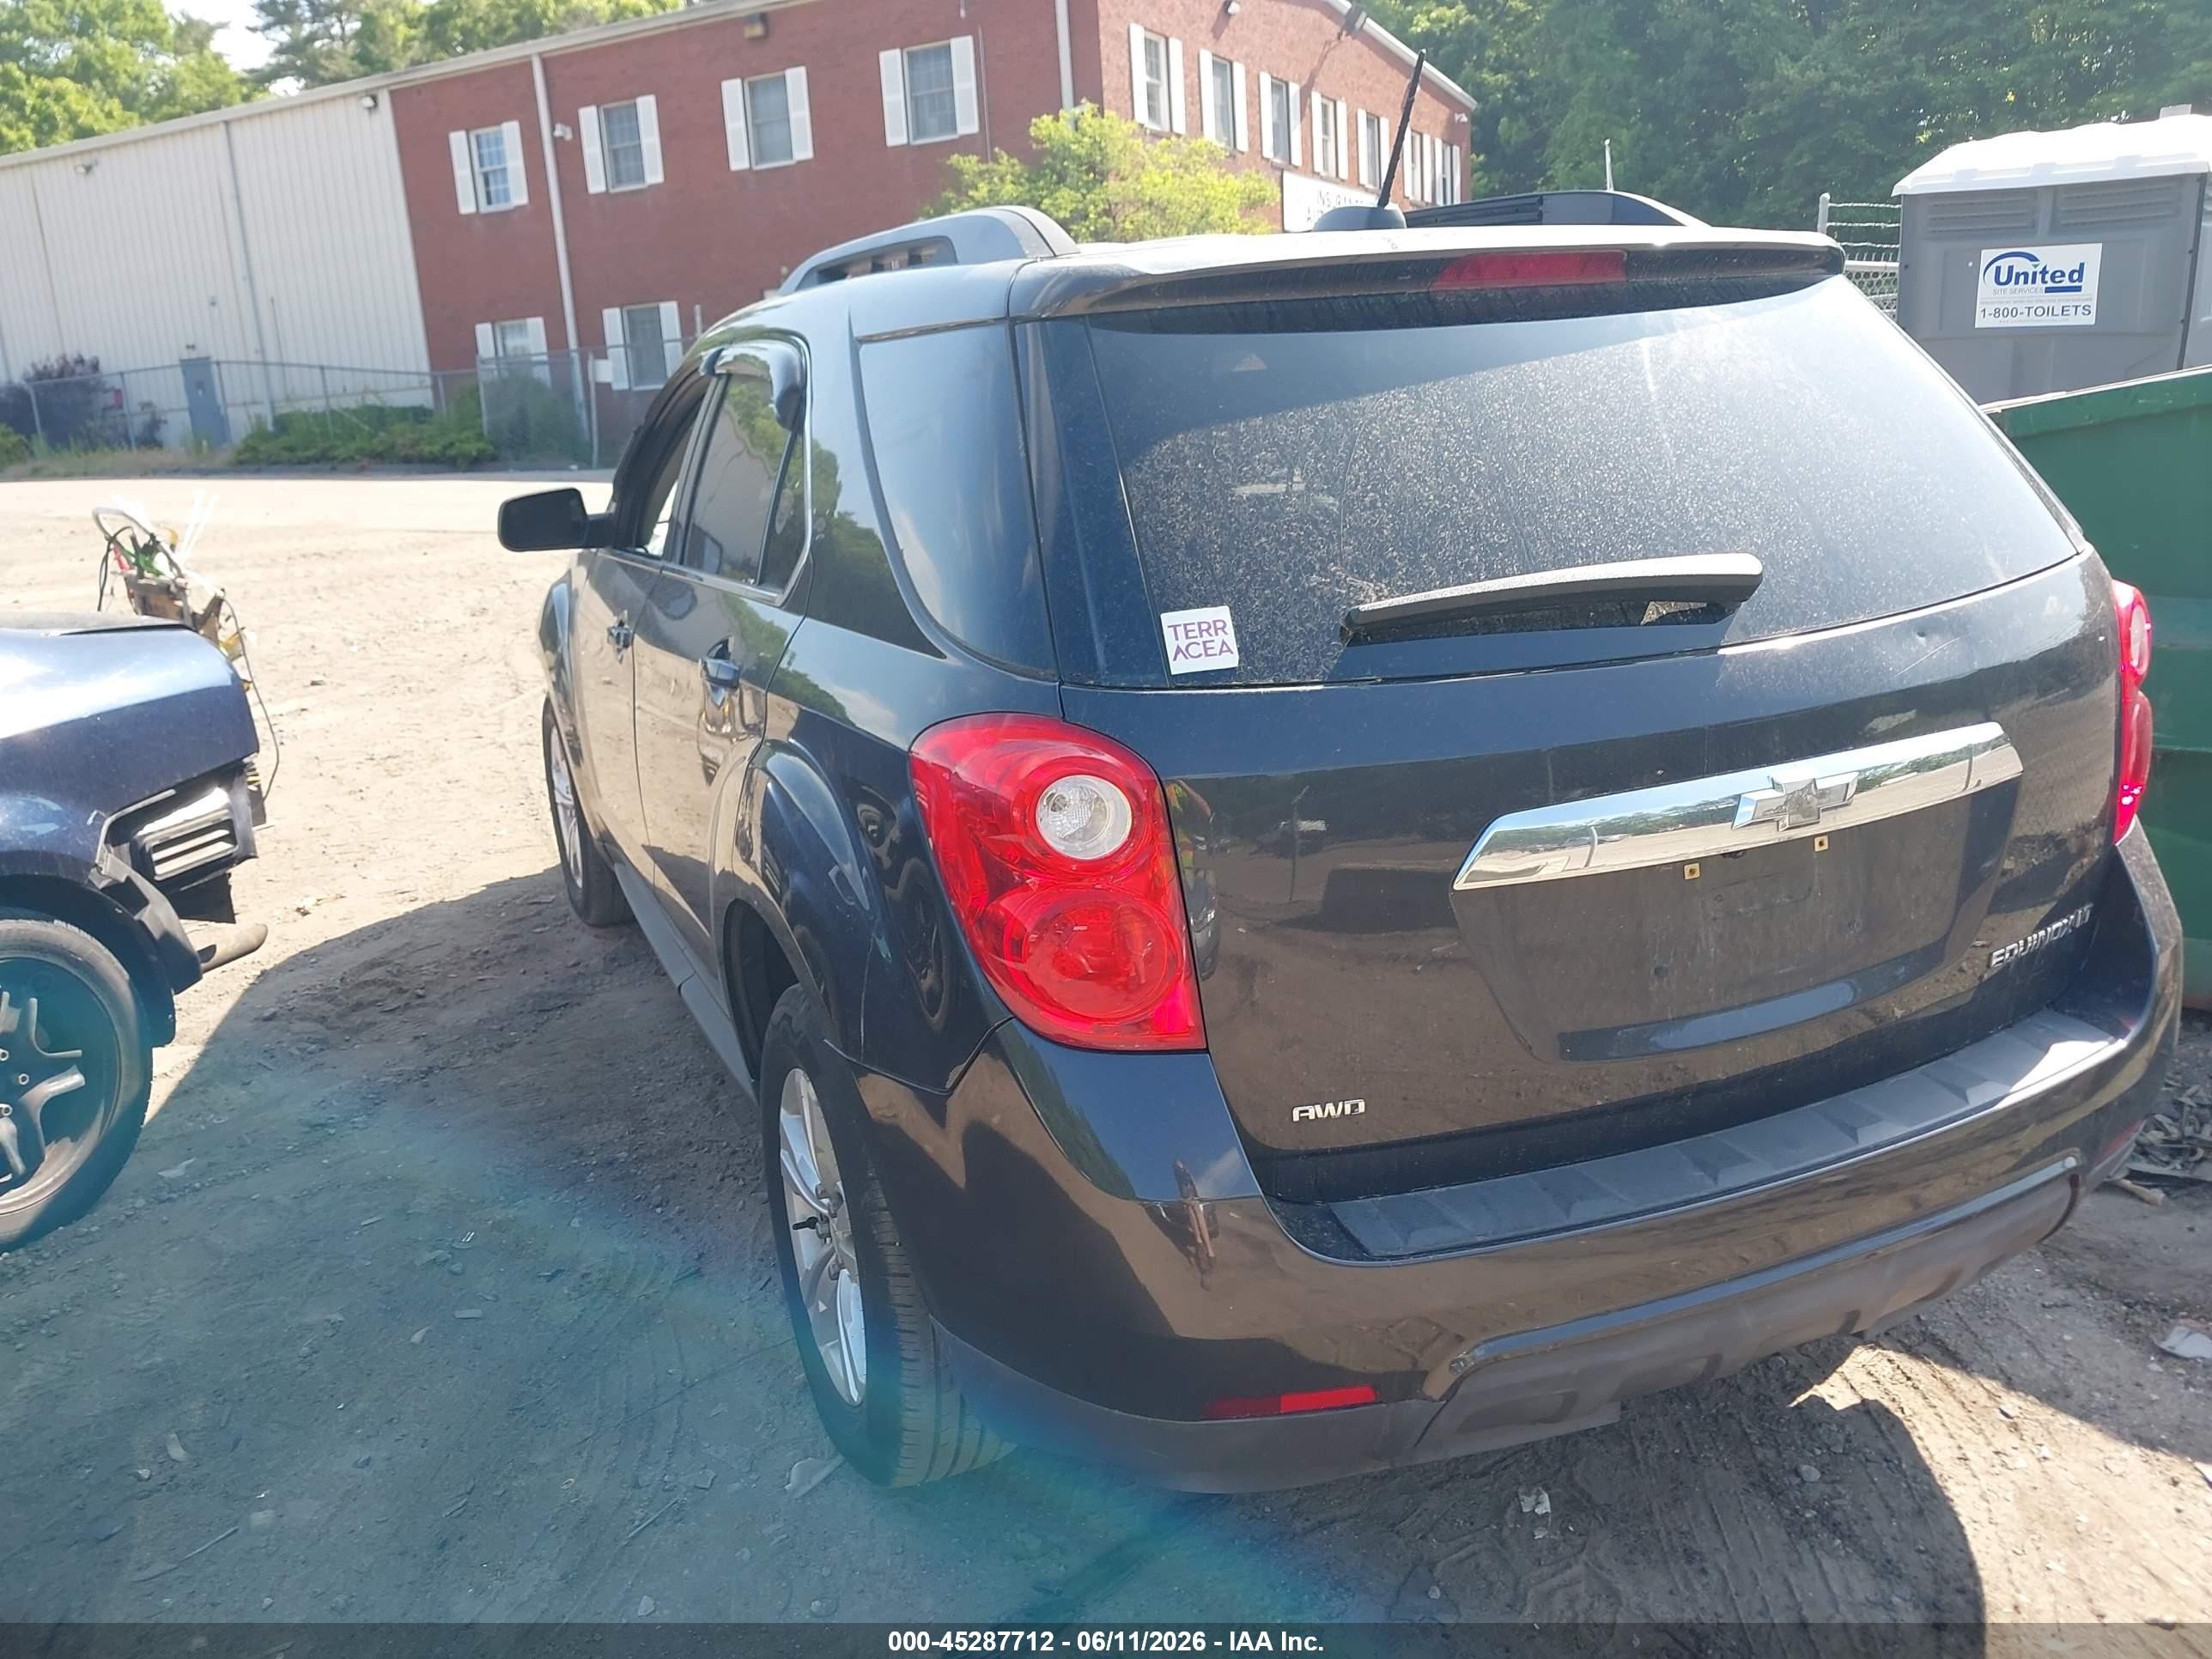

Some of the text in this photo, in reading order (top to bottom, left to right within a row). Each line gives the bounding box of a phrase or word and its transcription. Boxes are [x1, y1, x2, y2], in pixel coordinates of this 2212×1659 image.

[1994, 261, 2085, 286] United
[2008, 287, 2044, 295] SERVICES
[1980, 305, 2092, 319] 1-800-TOILETS
[1167, 619, 1229, 641] TERR
[1172, 639, 1234, 662] ACEA
[1292, 1098, 1365, 1121] AWD
